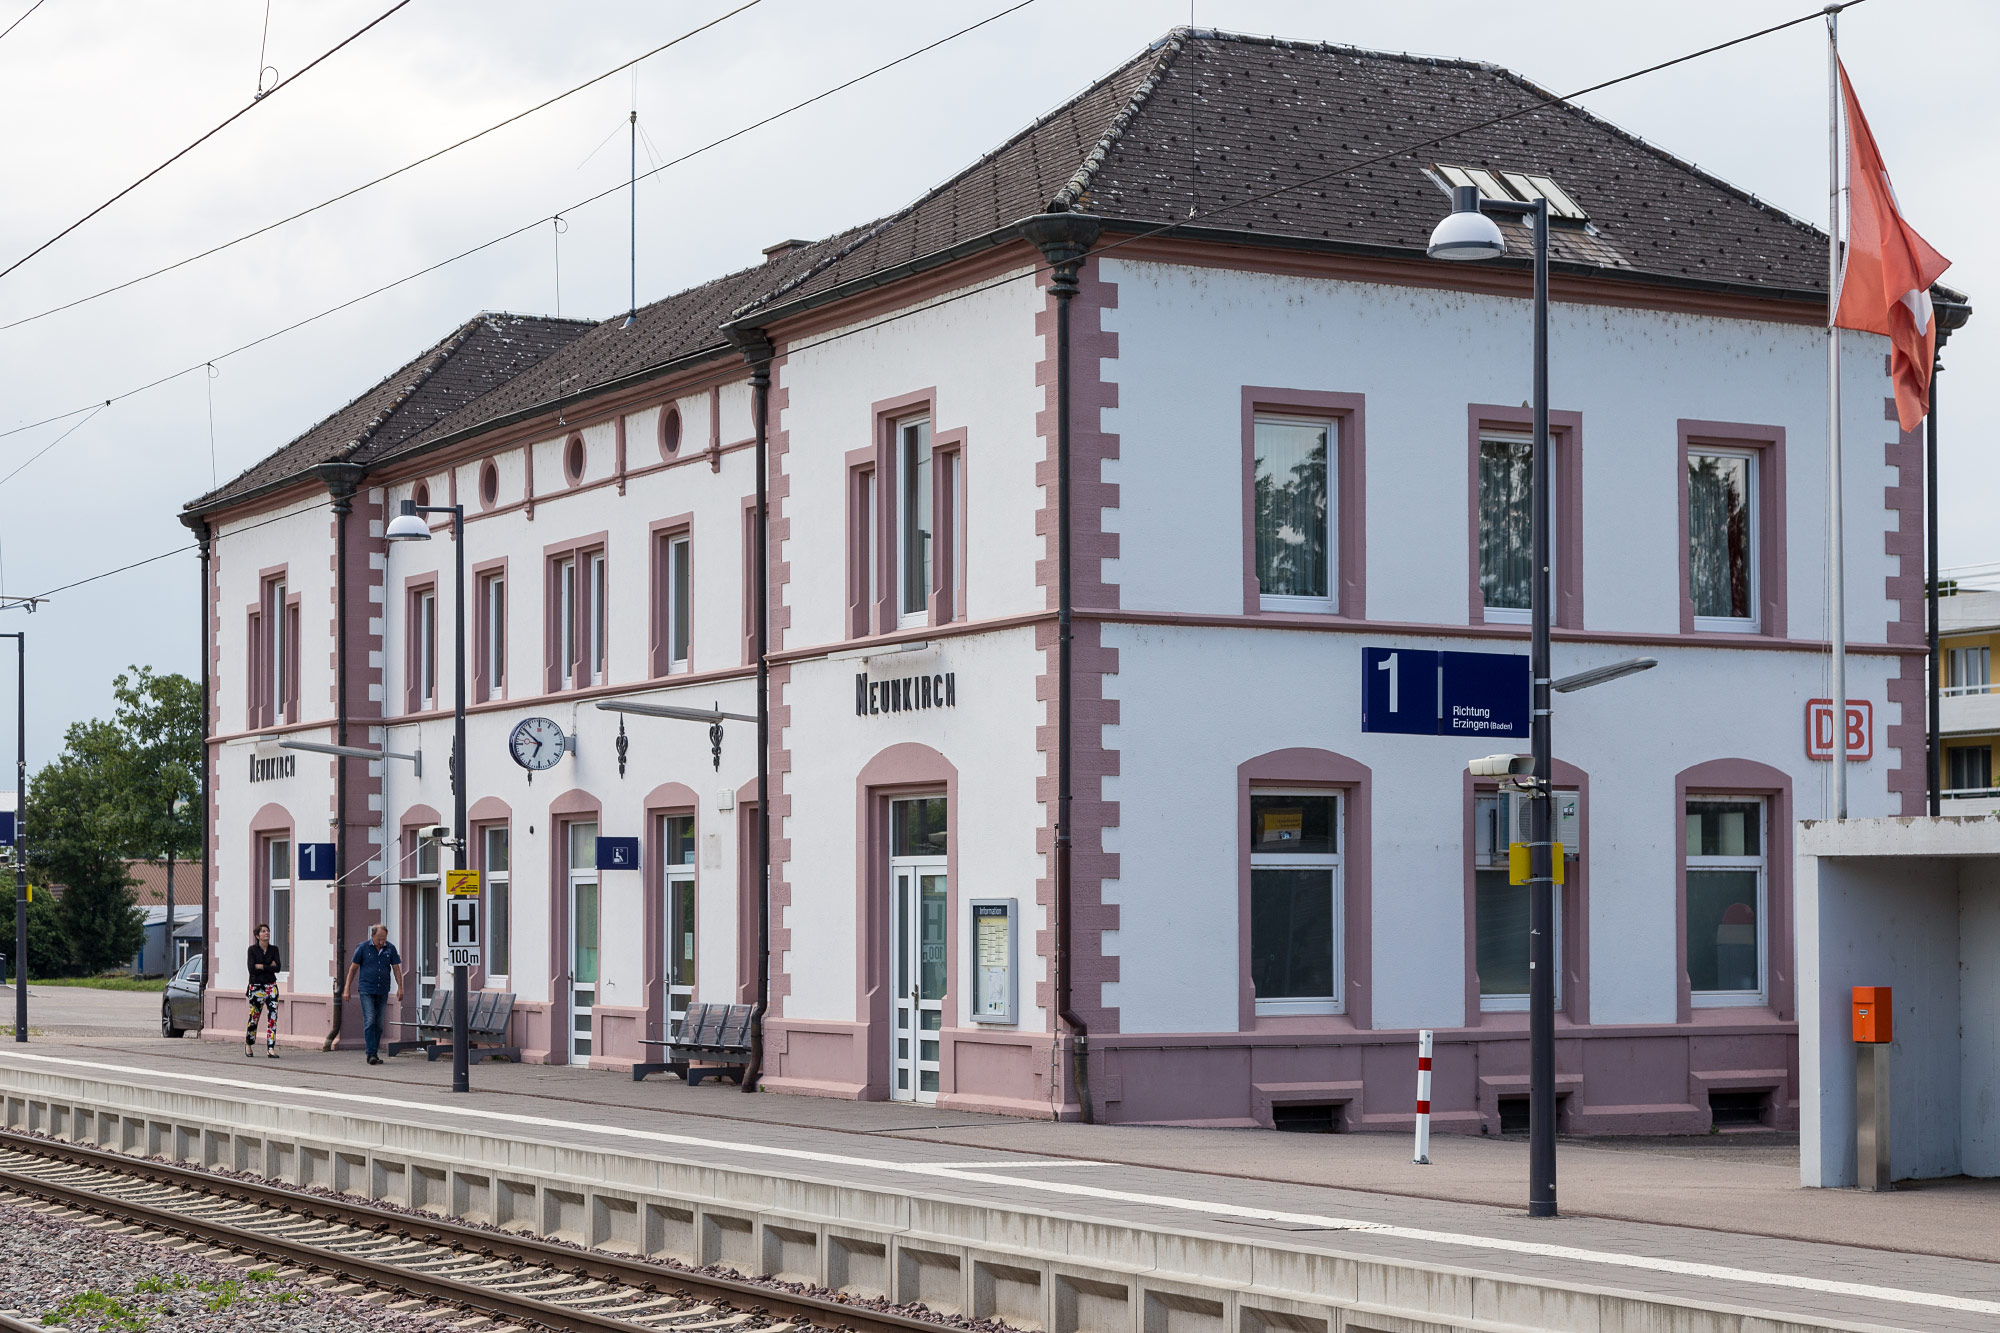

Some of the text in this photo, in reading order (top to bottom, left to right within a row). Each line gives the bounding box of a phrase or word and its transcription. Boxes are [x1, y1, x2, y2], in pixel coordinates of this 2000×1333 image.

[855, 672, 955, 717] NEUNKIRCH
[1377, 652, 1398, 713] 1
[1453, 705, 1490, 719] Richtung
[1453, 718, 1513, 731] Erzingen (Baden)
[1815, 708, 1865, 750] DB
[249, 753, 296, 783] NEUNKIRCH
[304, 844, 316, 872] 1
[452, 903, 476, 943] H
[979, 906, 1002, 916] Information
